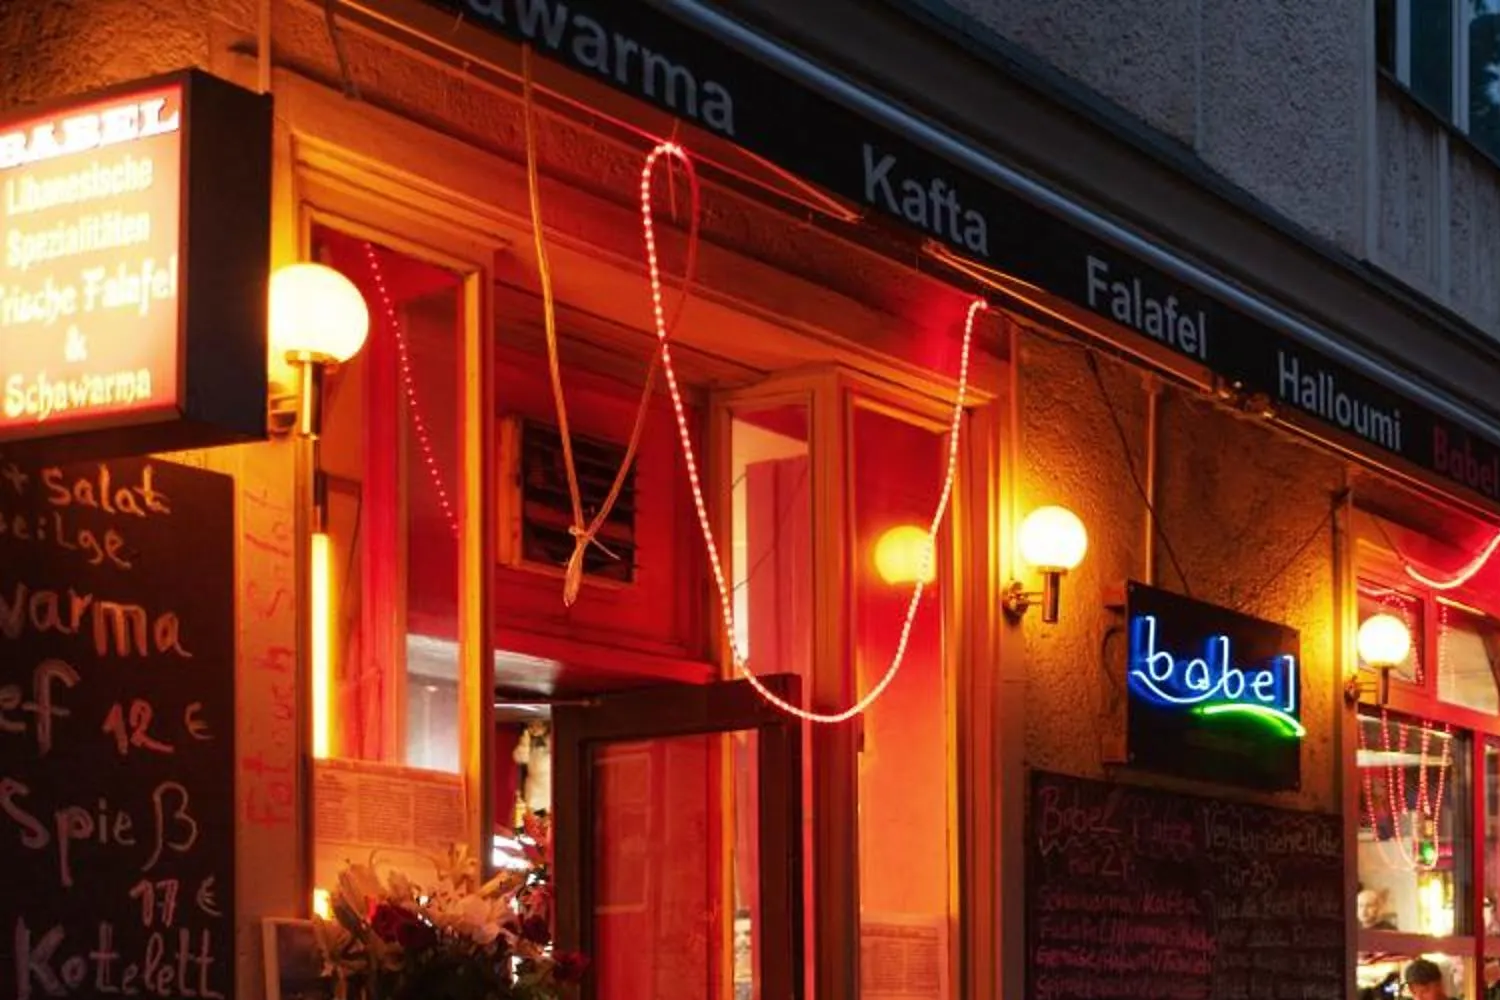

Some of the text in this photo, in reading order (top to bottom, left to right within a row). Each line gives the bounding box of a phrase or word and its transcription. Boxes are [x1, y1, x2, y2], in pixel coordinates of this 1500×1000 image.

[862, 143, 990, 257] Kafta
[1086, 255, 1208, 360] Falafel
[1278, 350, 1401, 451] Halloumi
[42, 464, 171, 516] Salat
[1432, 425, 1499, 497] Babel
[0, 510, 132, 569] eilge
[1146, 615, 1295, 712] babel
[103, 699, 174, 754] 12
[130, 879, 179, 926] 17
